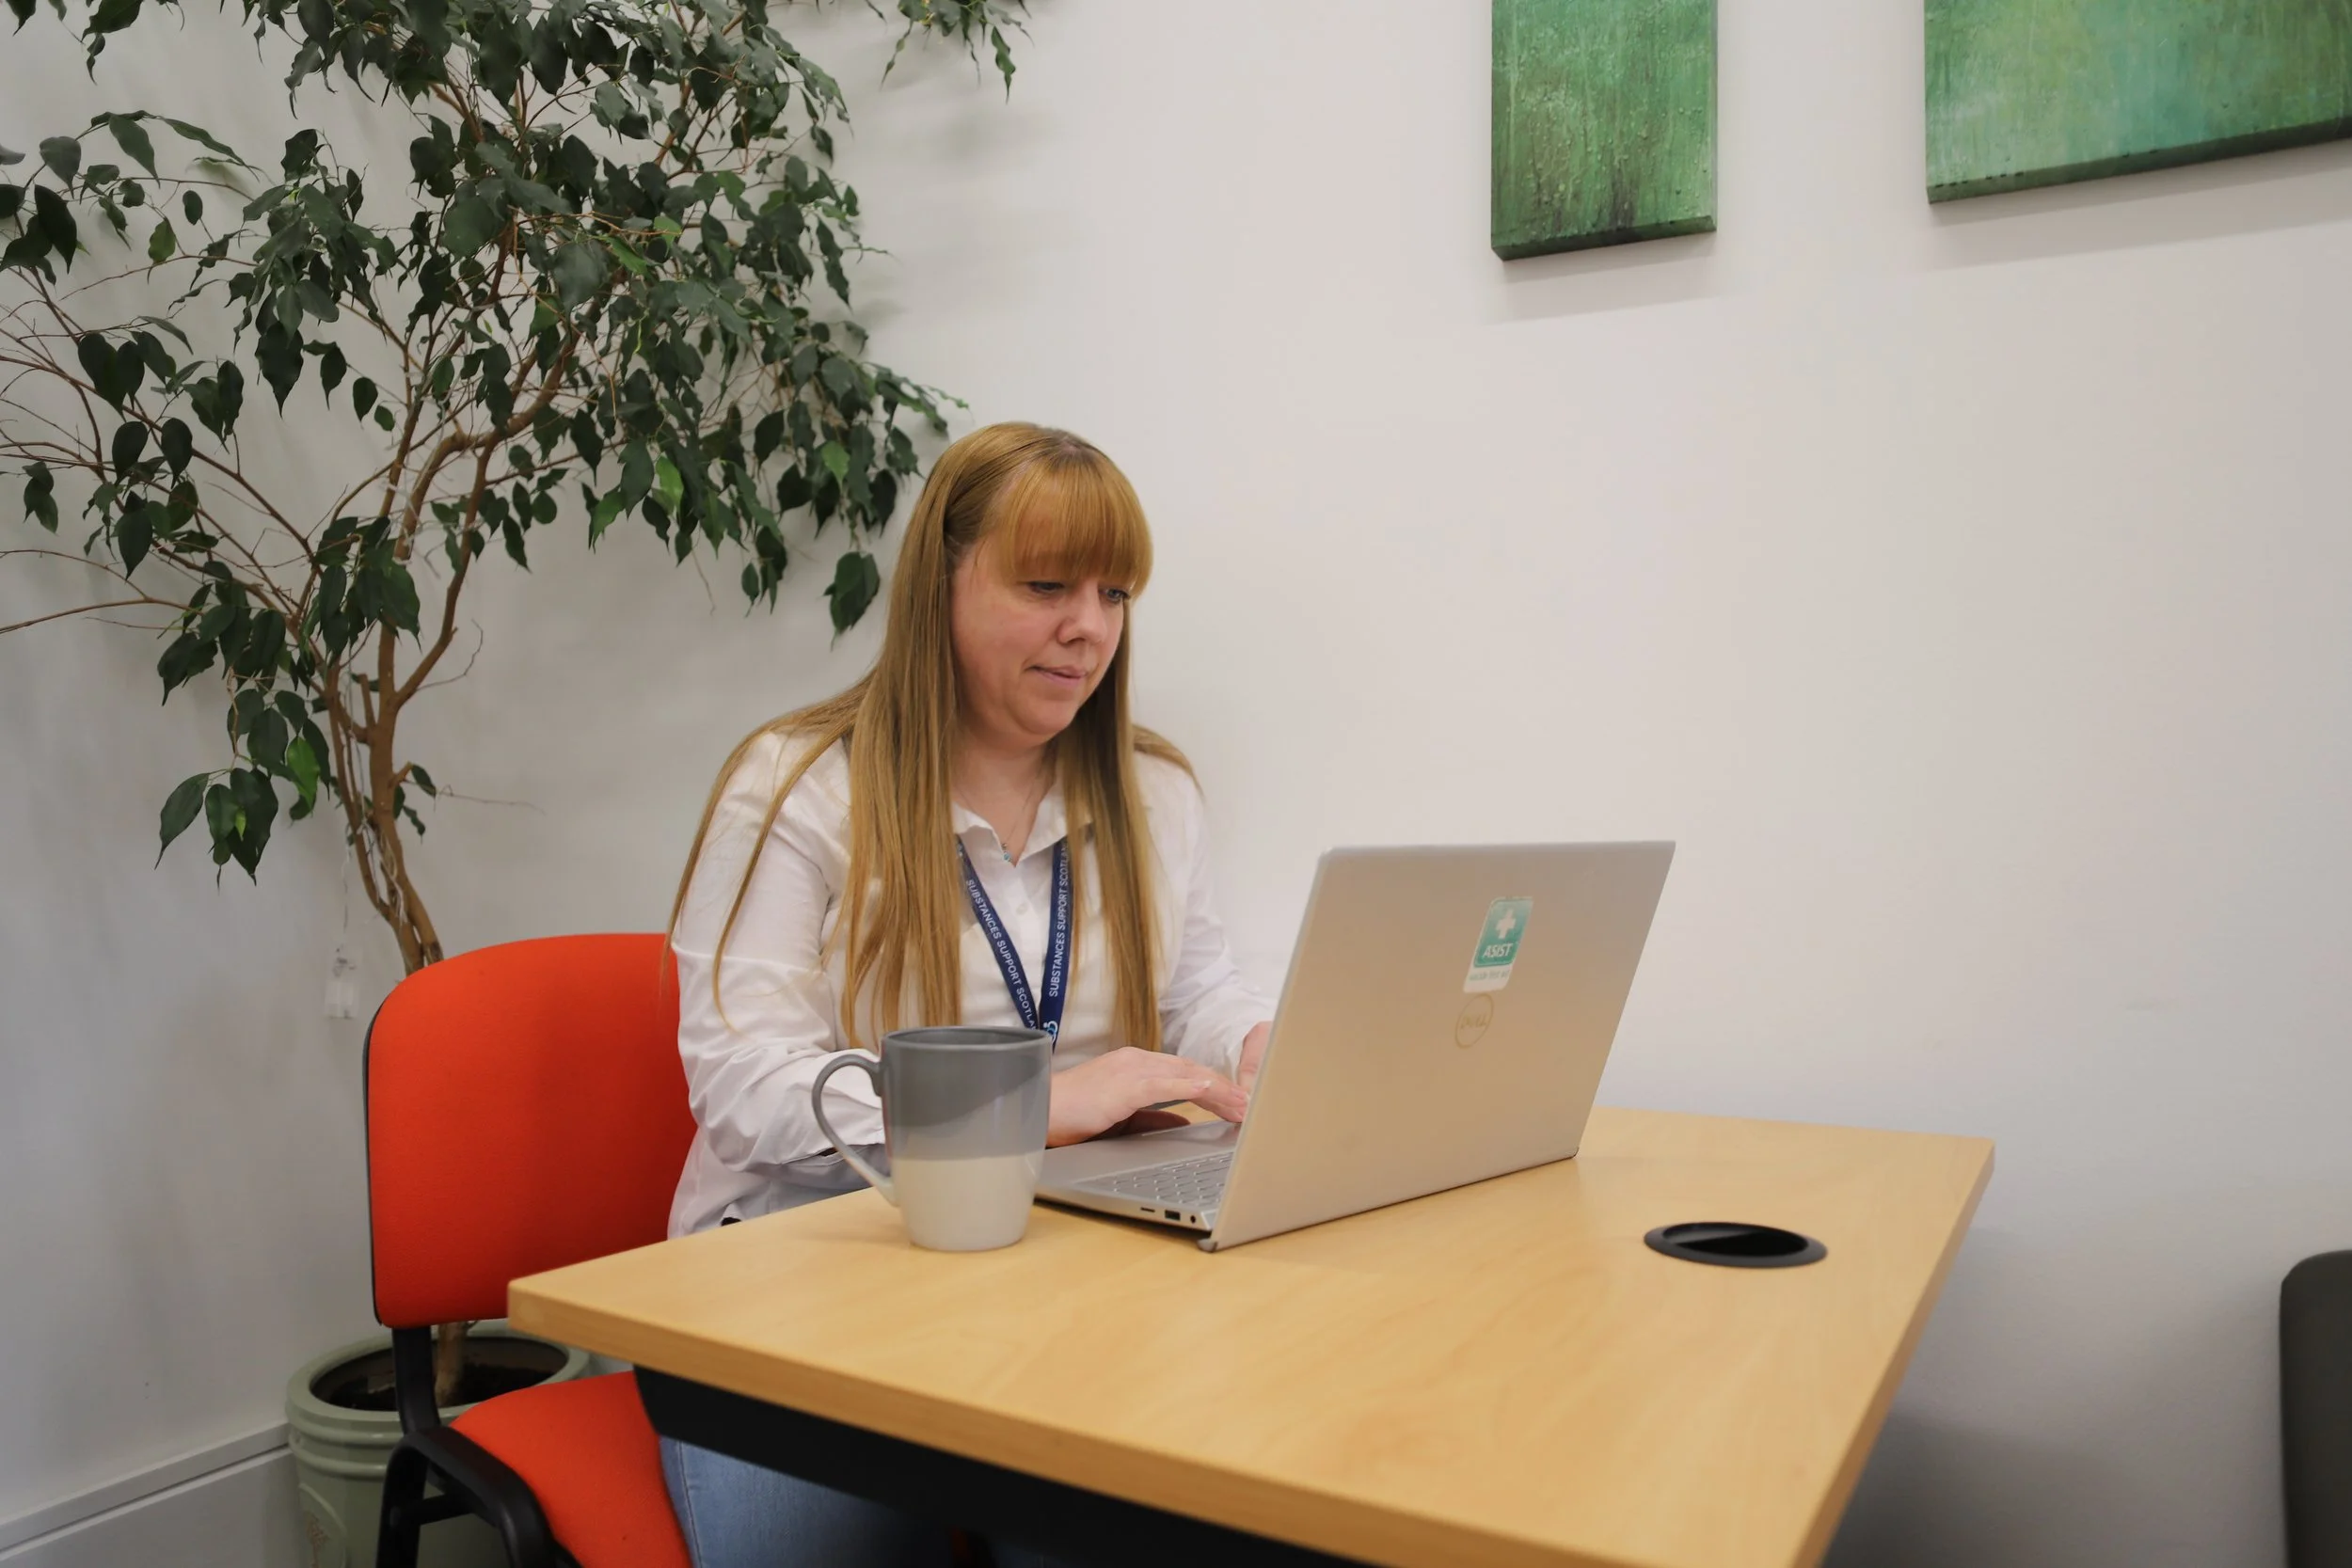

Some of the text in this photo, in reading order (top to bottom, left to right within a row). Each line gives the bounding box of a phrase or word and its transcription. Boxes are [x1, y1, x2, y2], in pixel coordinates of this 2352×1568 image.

[965, 879, 1003, 940] SUBSTANCES
[996, 940, 1023, 986] SUPPORT
[1048, 932, 1065, 998] SUBSTANCES
[1057, 888, 1070, 931] SUPPORT
[1482, 942, 1514, 958] ASIST
